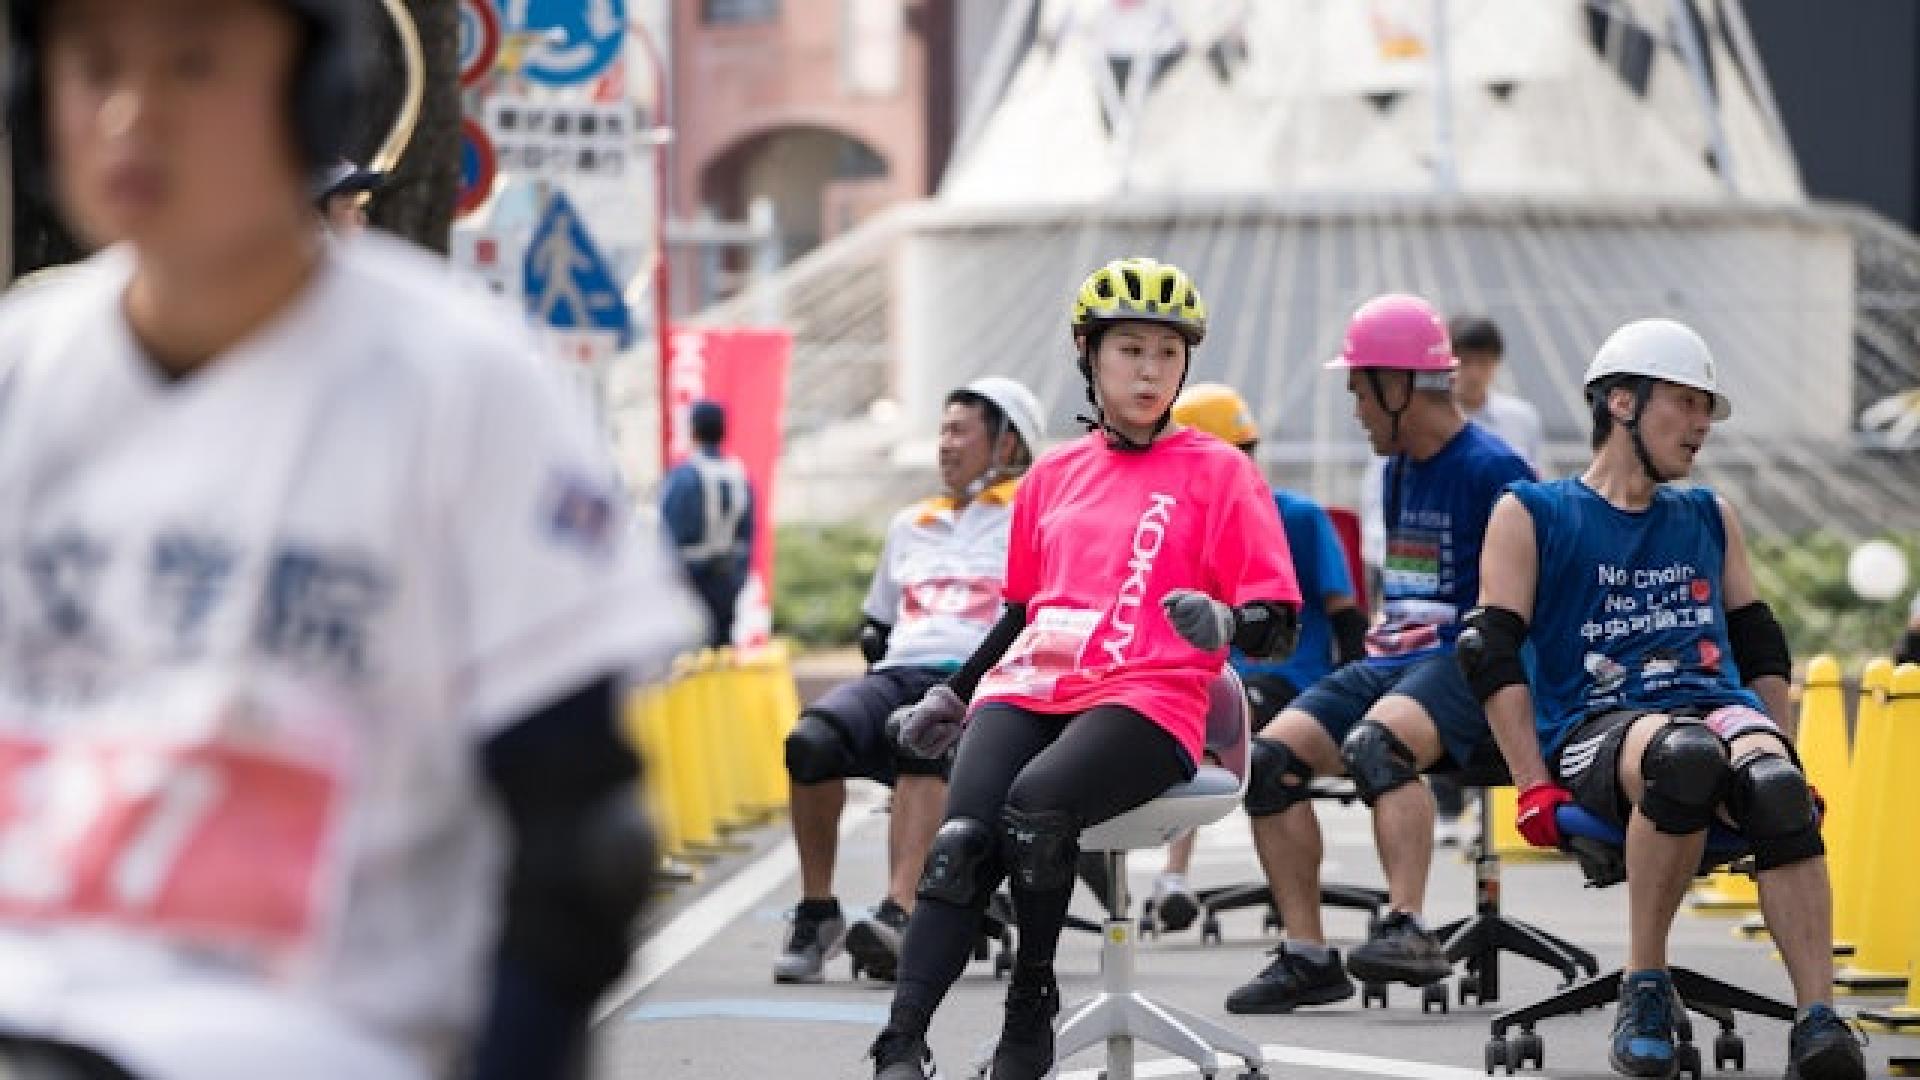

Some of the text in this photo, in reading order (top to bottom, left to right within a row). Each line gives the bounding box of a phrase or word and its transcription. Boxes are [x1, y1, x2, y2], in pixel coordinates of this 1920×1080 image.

[1101, 491, 1177, 668] KOKUY
[1598, 563, 1629, 586] No
[1604, 593, 1636, 613] No
